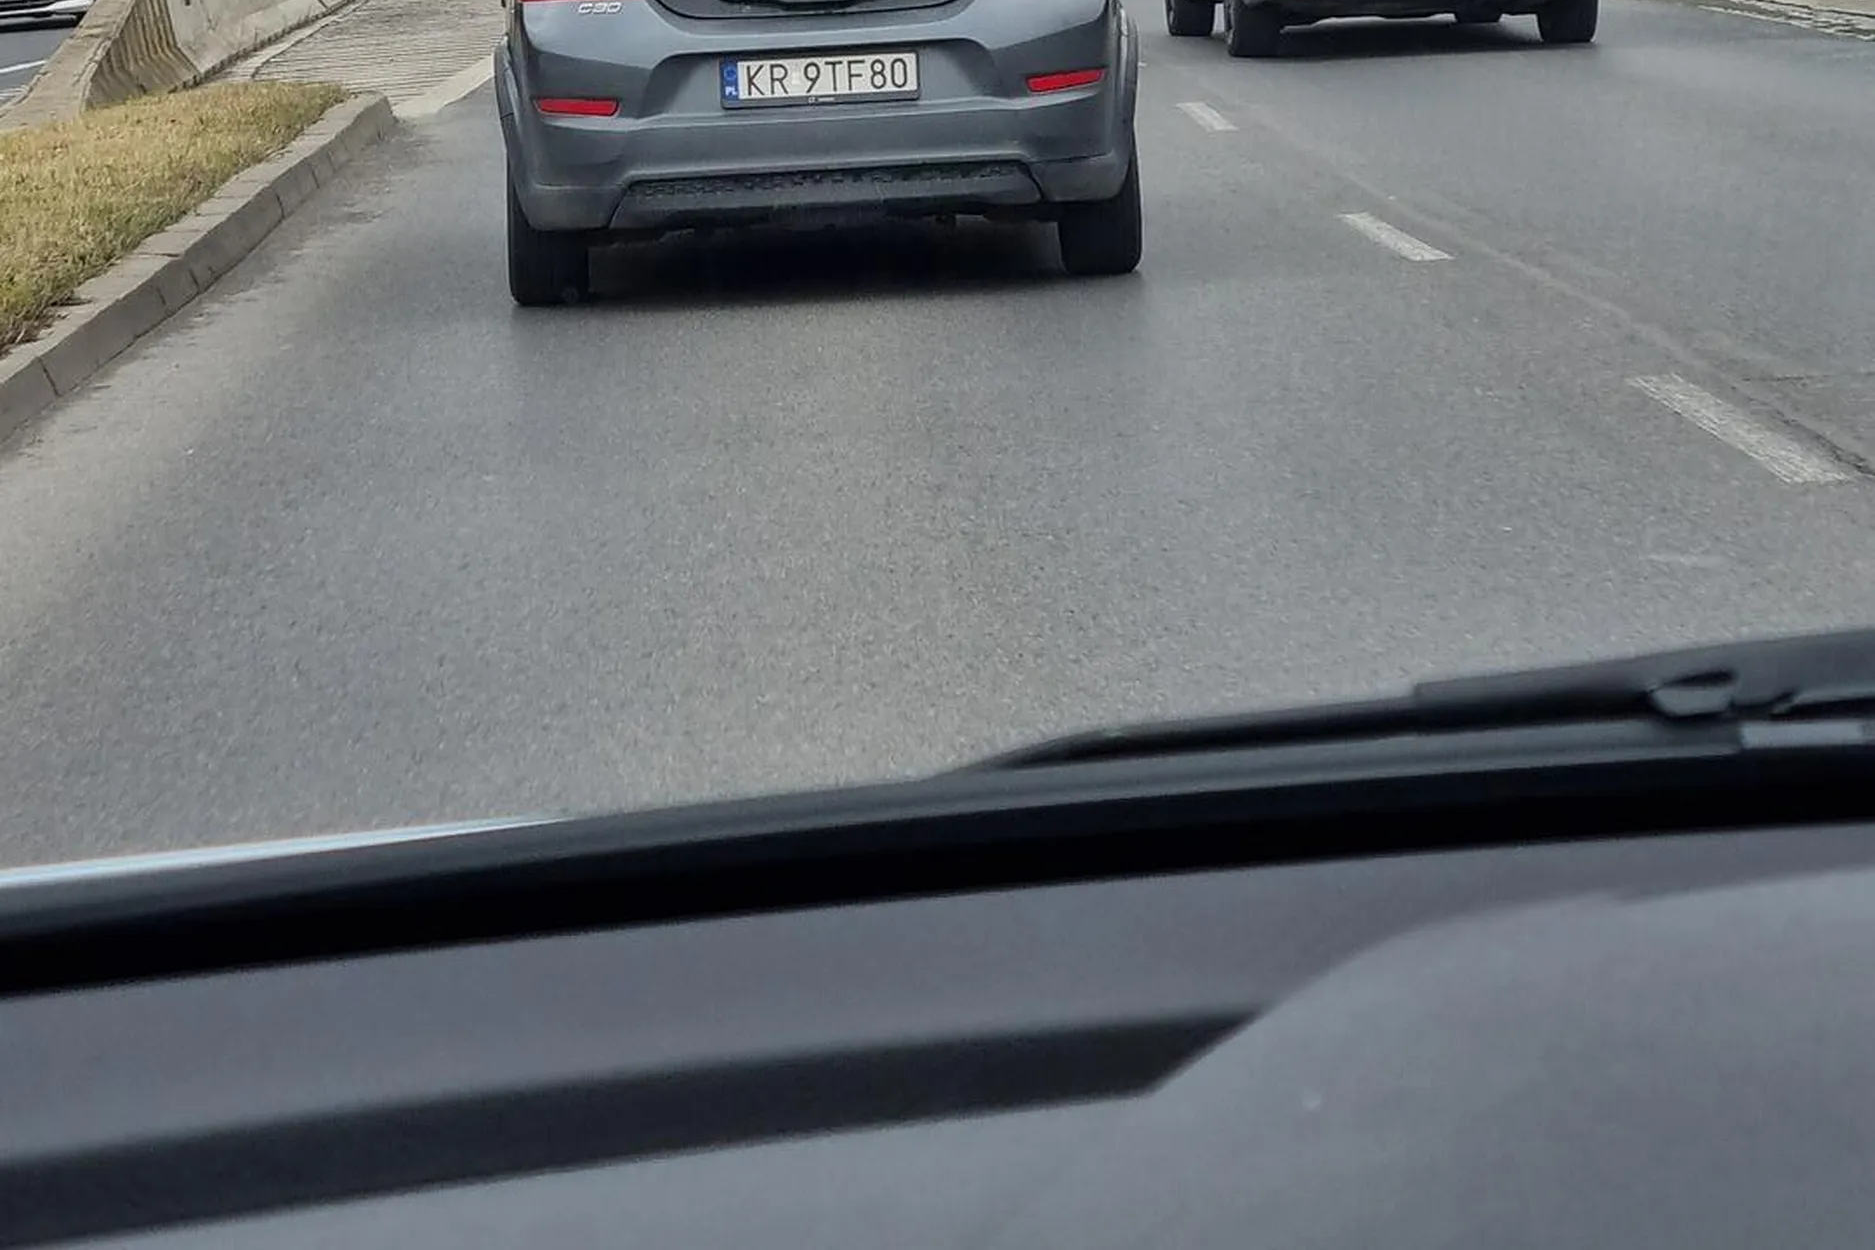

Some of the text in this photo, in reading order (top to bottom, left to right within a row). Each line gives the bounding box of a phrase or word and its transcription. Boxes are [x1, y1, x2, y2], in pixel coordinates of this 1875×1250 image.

[746, 58, 908, 96] KR 9TF80
[725, 86, 738, 95] PL
